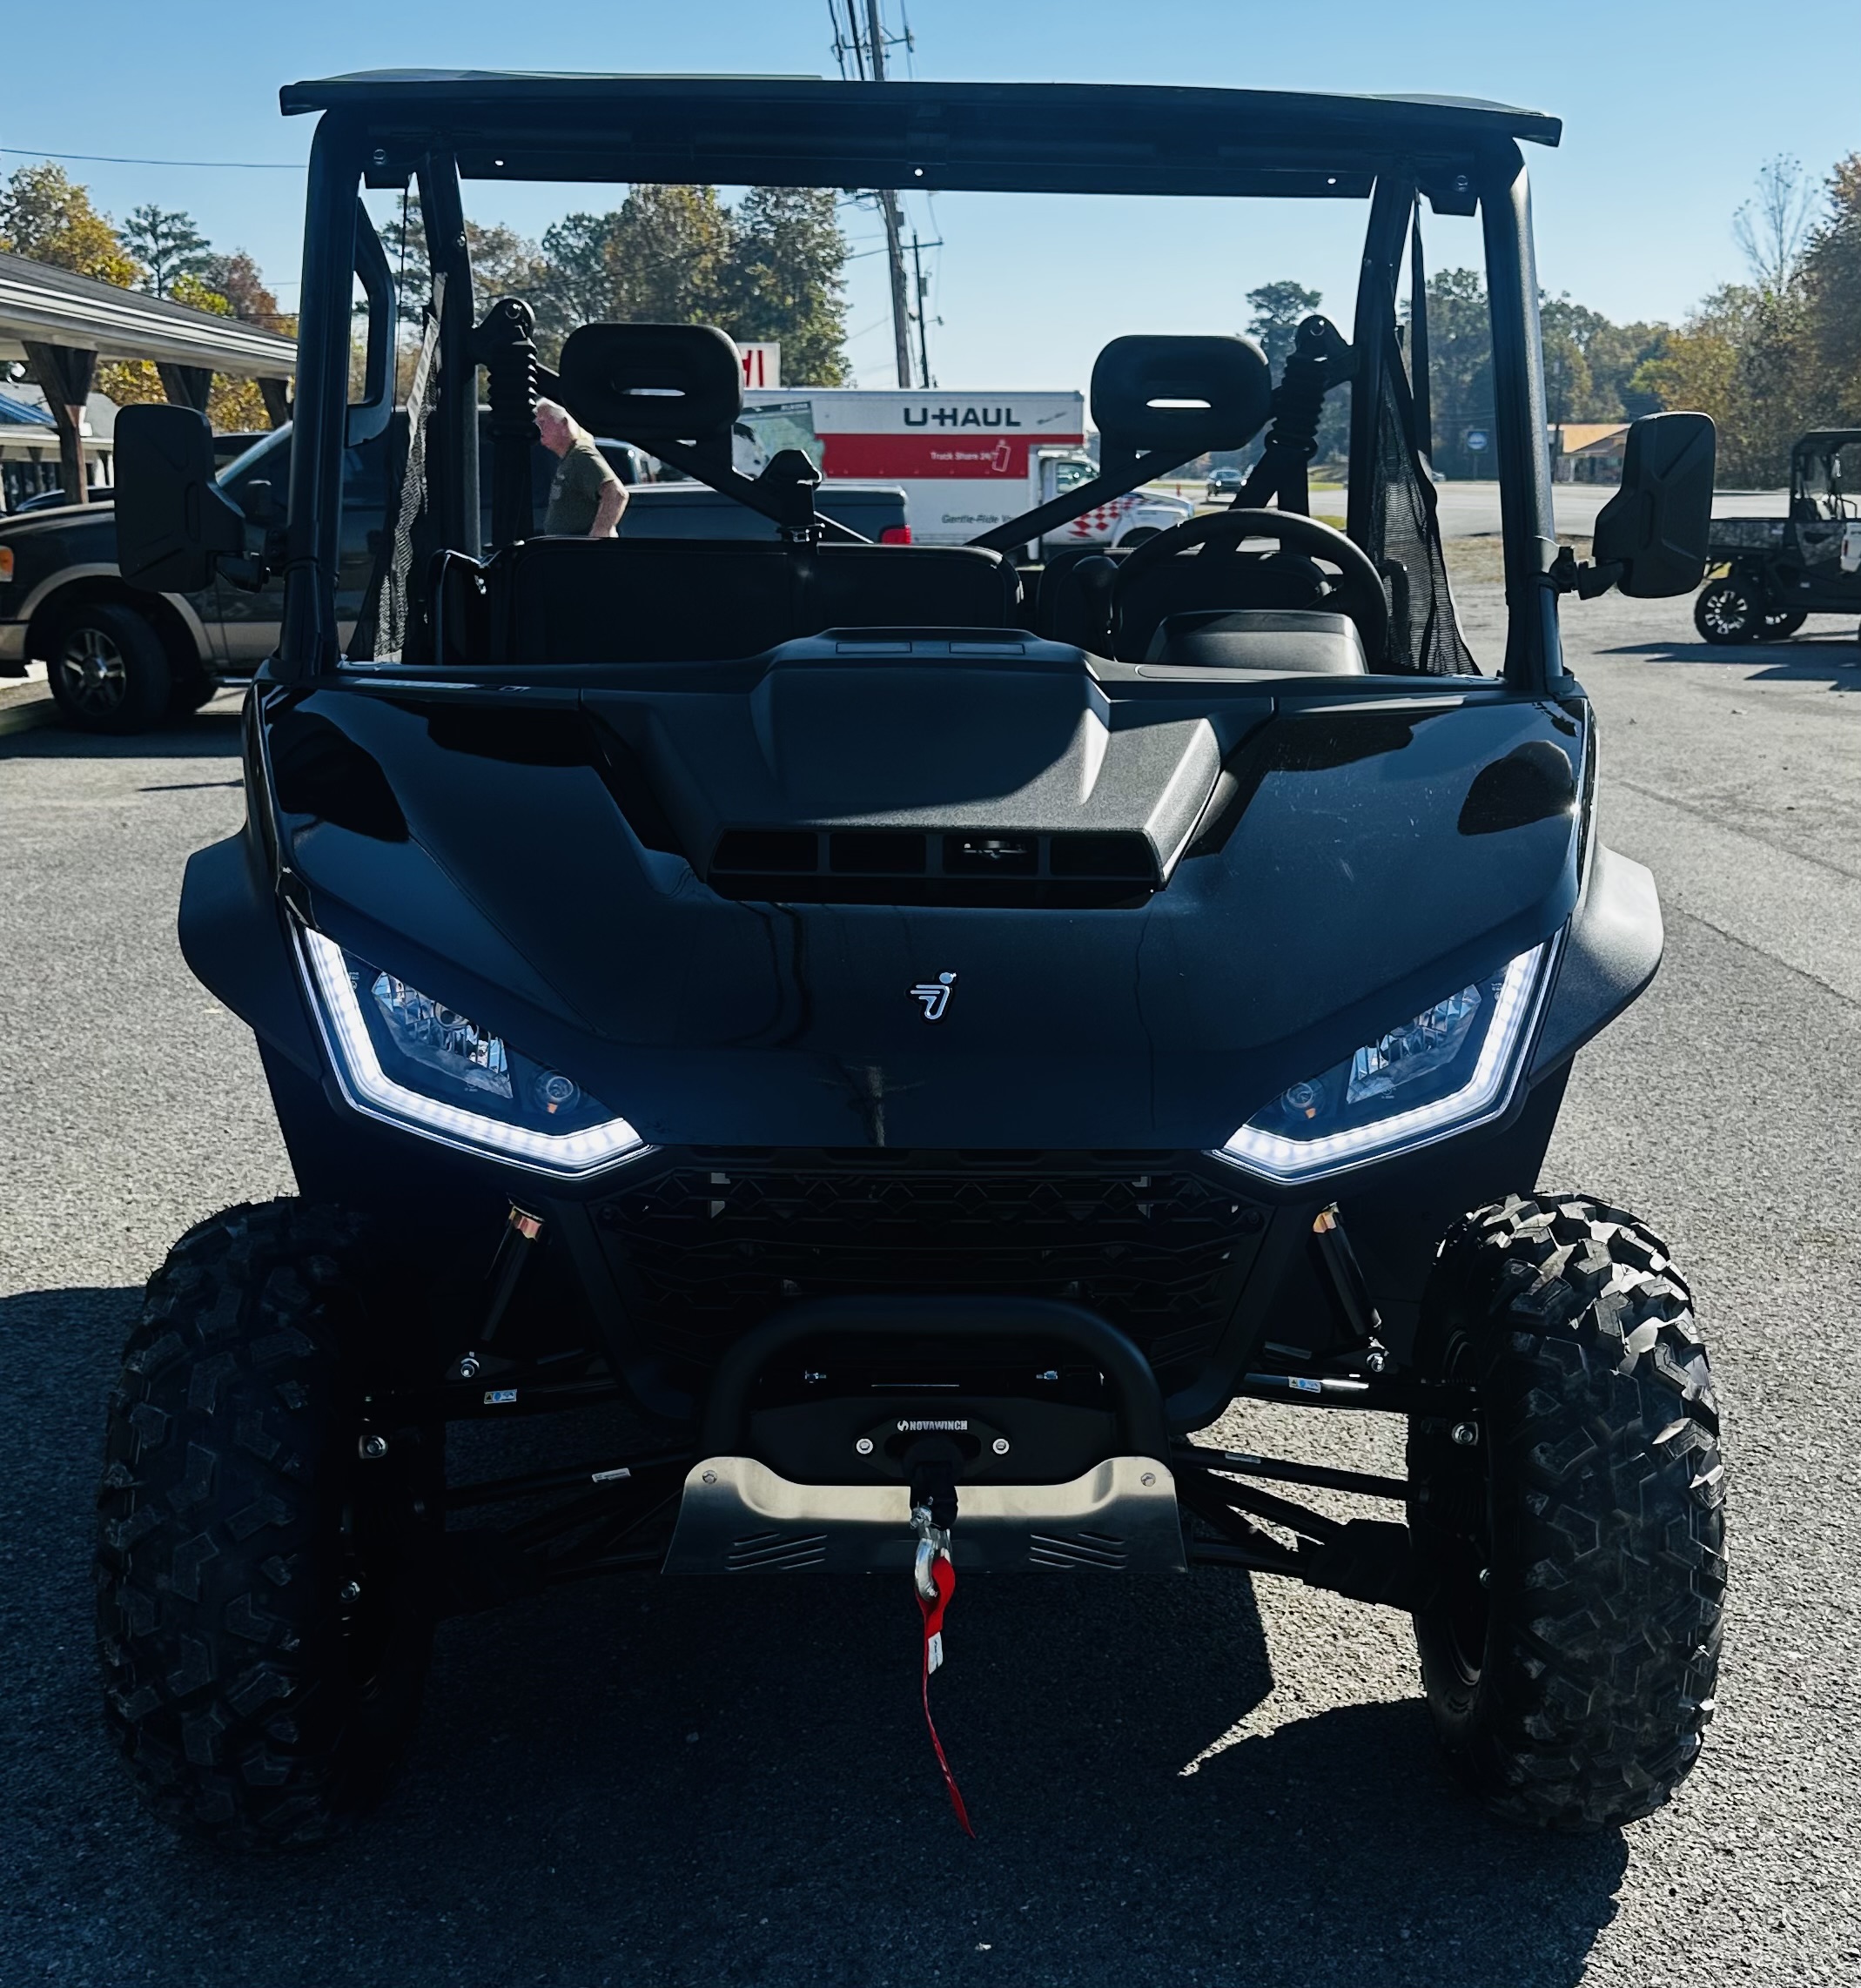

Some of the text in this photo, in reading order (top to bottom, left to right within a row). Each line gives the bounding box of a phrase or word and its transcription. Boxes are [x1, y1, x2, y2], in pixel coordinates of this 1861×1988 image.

[904, 407, 1021, 426] U-HAUL
[930, 451, 953, 460] Truck
[910, 1420, 968, 1430] NOVAWINCH
